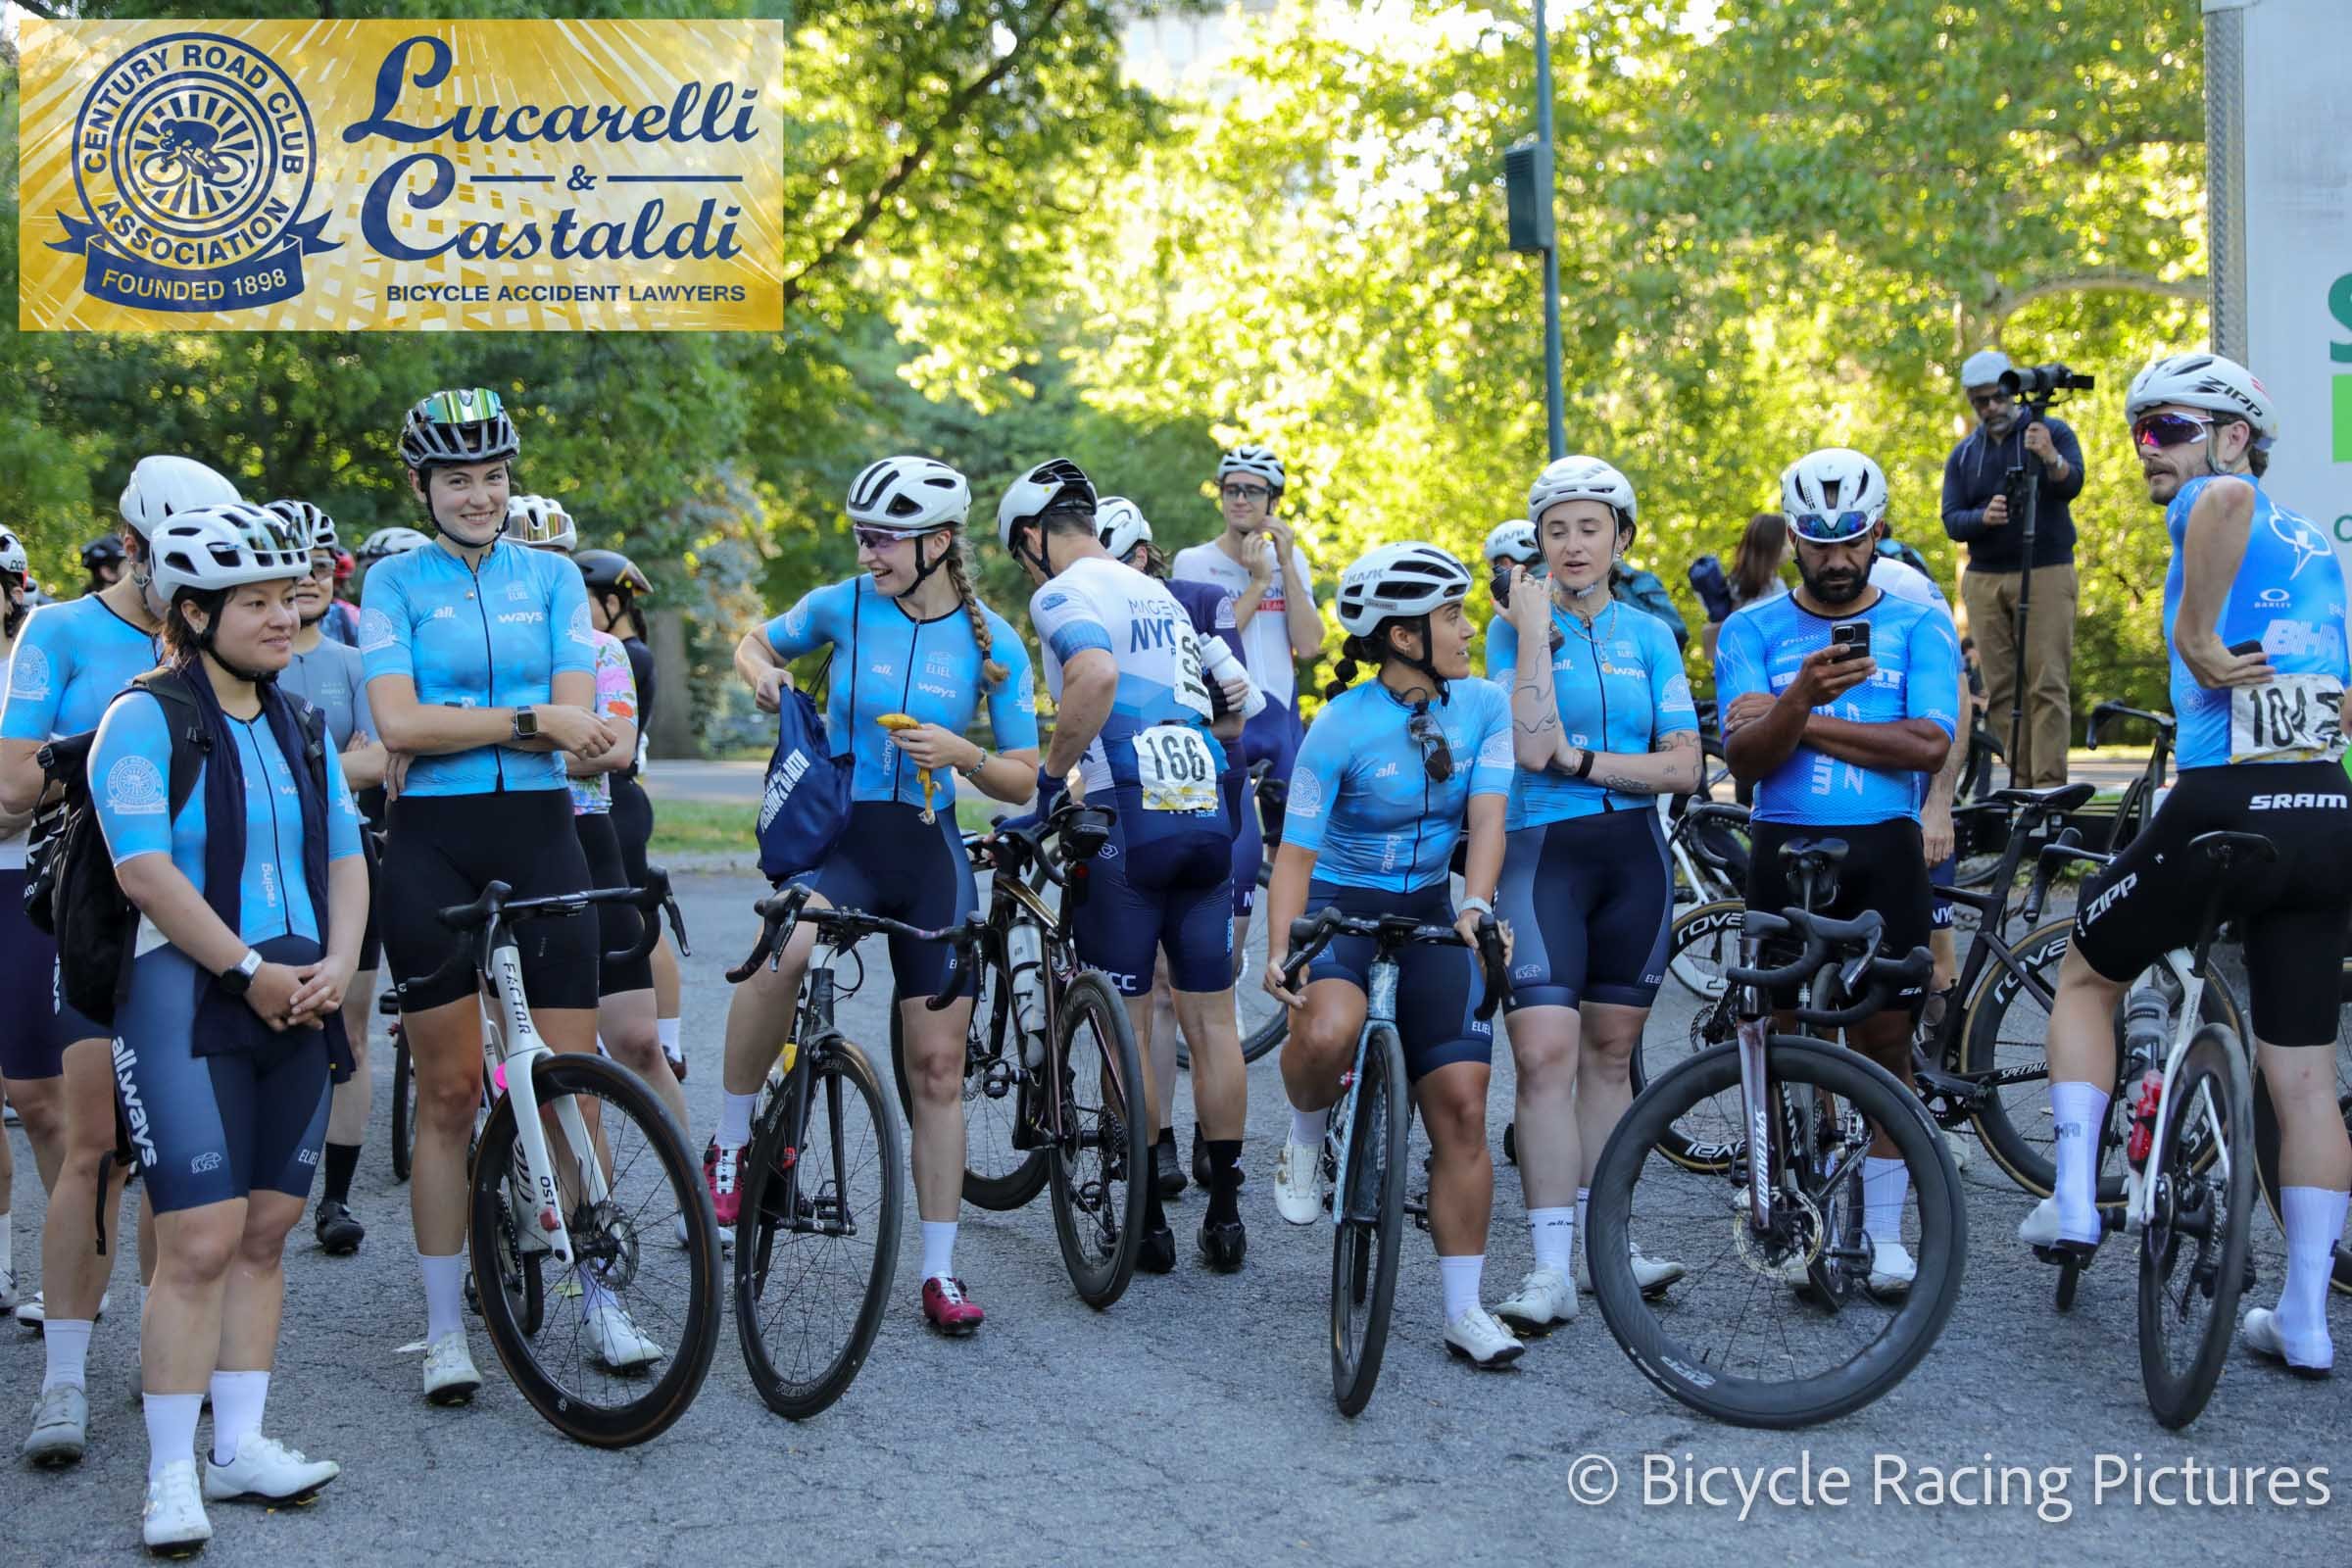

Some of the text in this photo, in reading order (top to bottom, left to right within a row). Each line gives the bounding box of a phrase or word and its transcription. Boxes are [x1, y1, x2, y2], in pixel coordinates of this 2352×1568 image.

[2199, 375, 2263, 417] ZIPP
[497, 611, 543, 625] ways
[917, 682, 957, 699] ways
[1146, 735, 1206, 782] 166
[2248, 793, 2348, 810] SRAM
[2086, 872, 2138, 926] ZIPP
[1471, 1021, 1492, 1036] ELIEL
